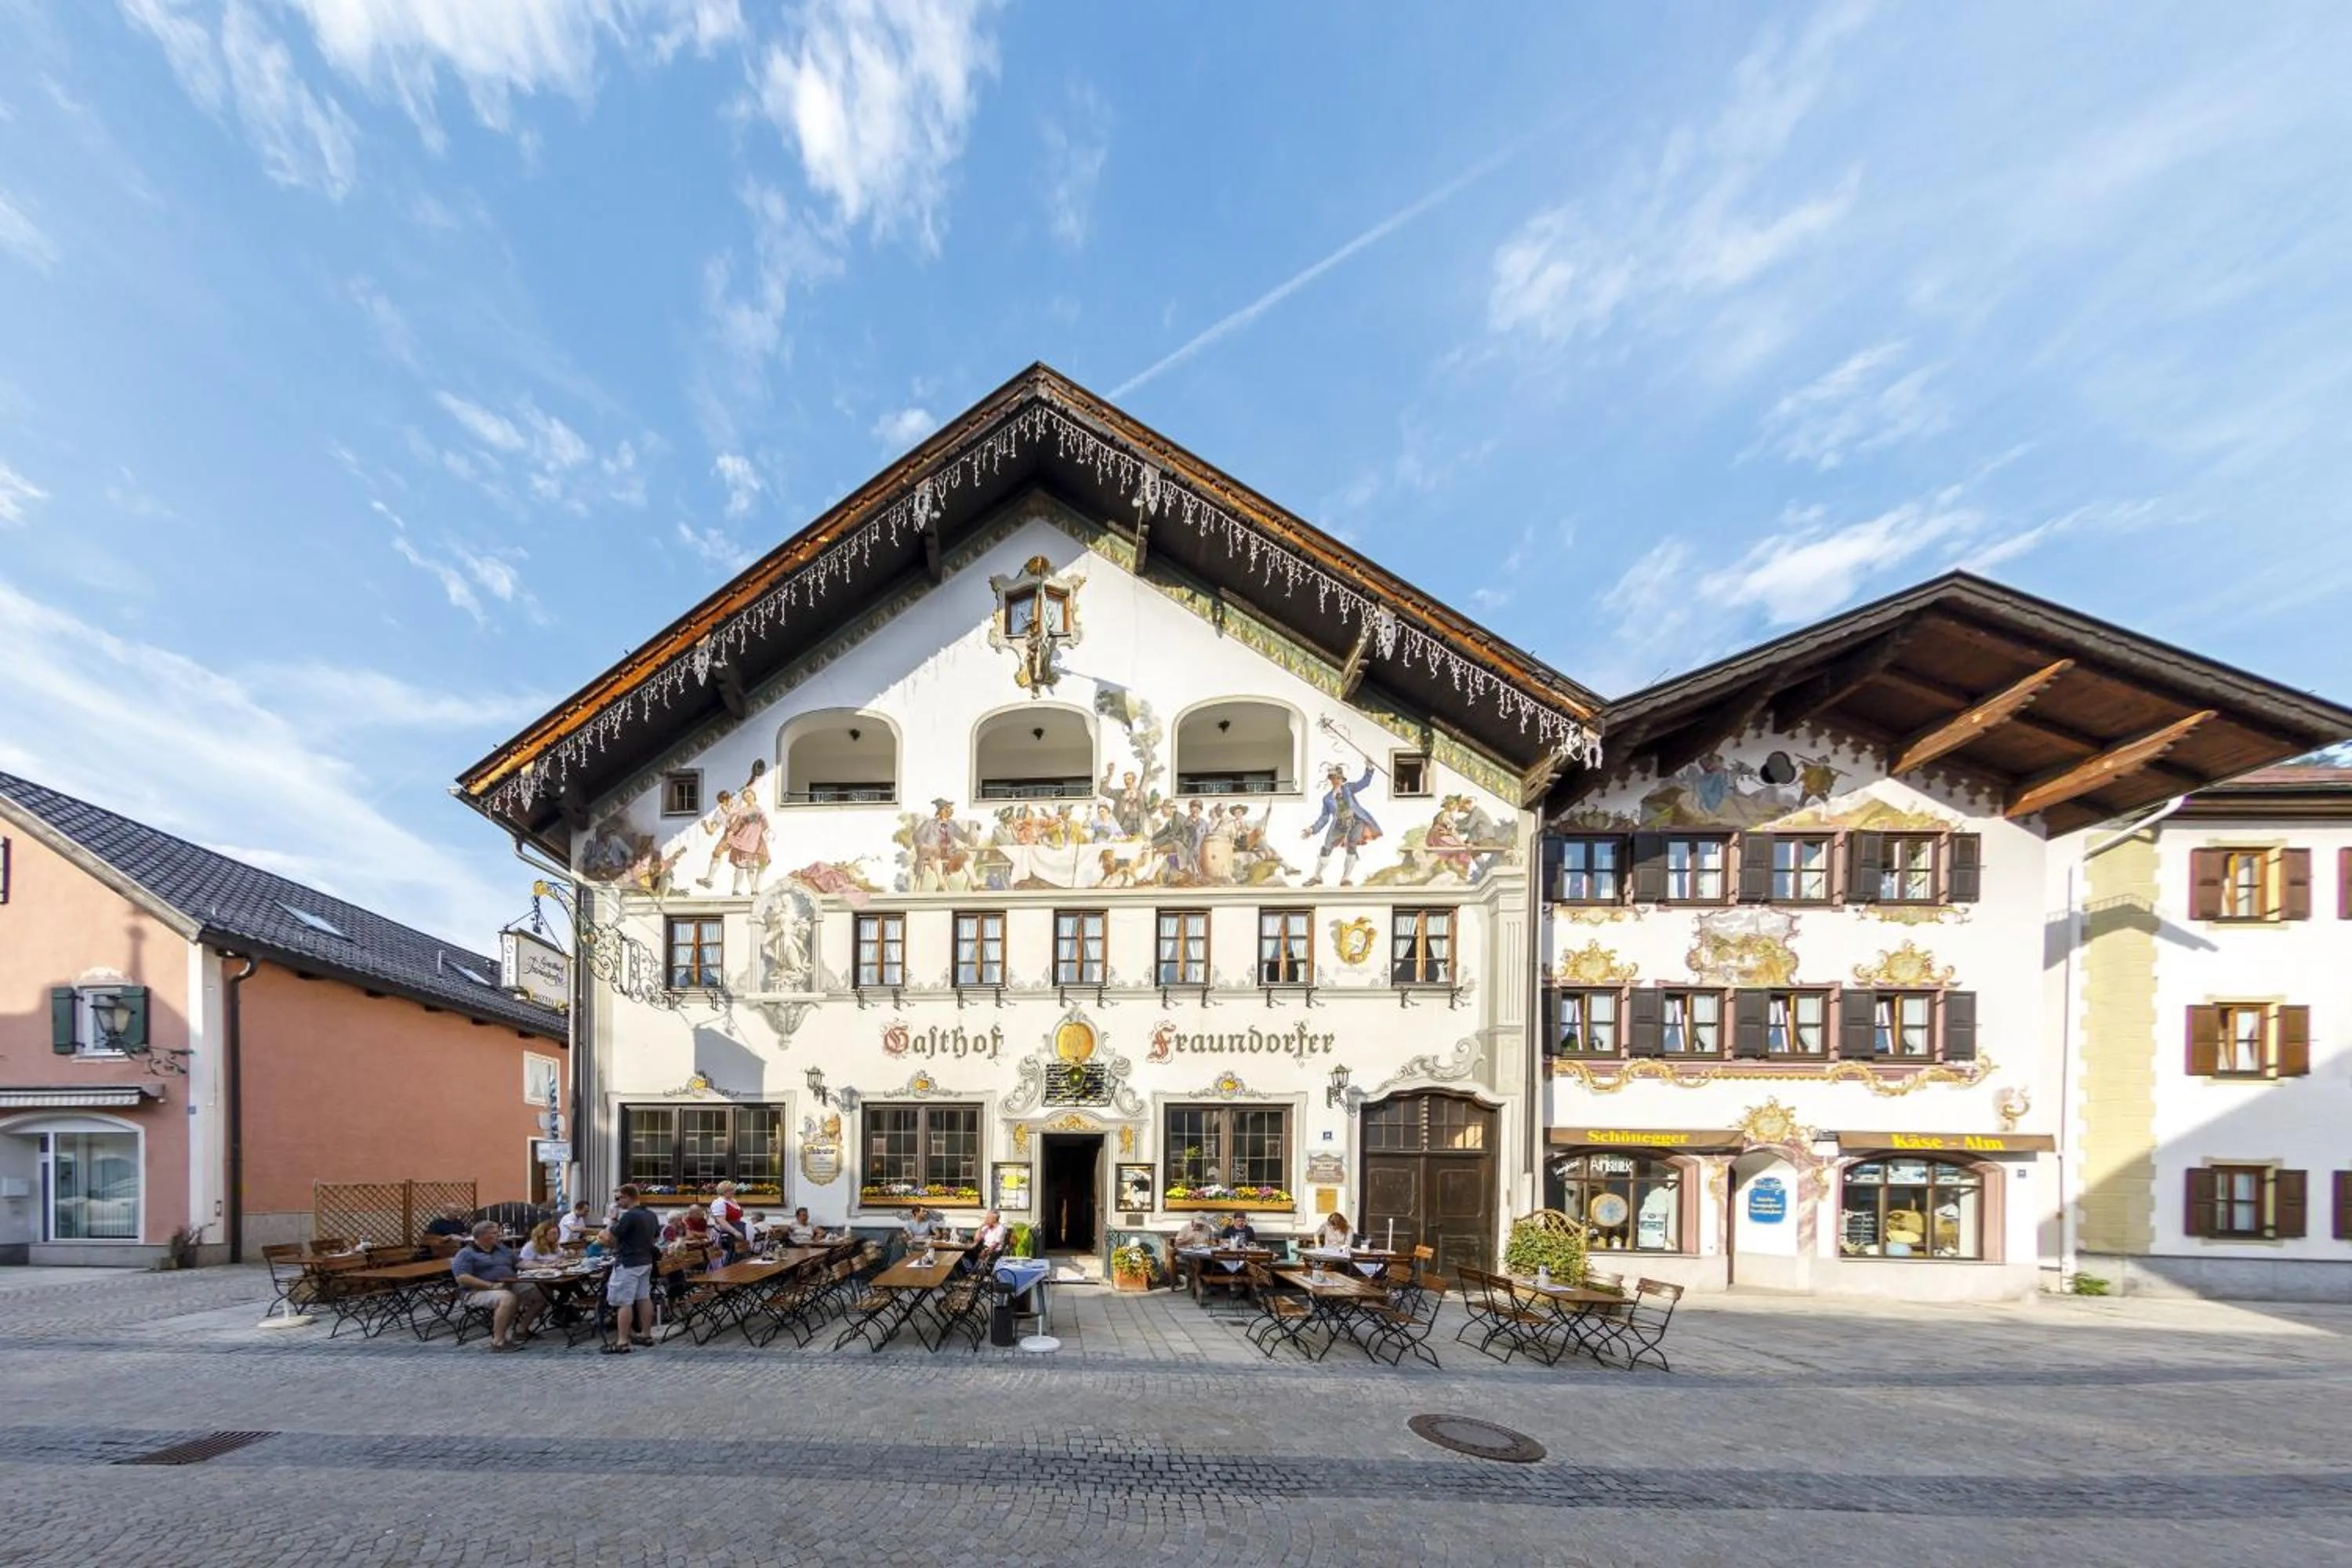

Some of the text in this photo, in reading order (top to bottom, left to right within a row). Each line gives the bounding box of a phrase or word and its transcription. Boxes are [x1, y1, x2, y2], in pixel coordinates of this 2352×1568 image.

[506, 935, 514, 986] HOTEL
[1146, 1021, 1334, 1065] Fraundorfer
[1586, 1129, 1690, 1147] Schönegger
[1891, 1133, 1945, 1149] Käse
[1965, 1134, 2005, 1151] Alm
